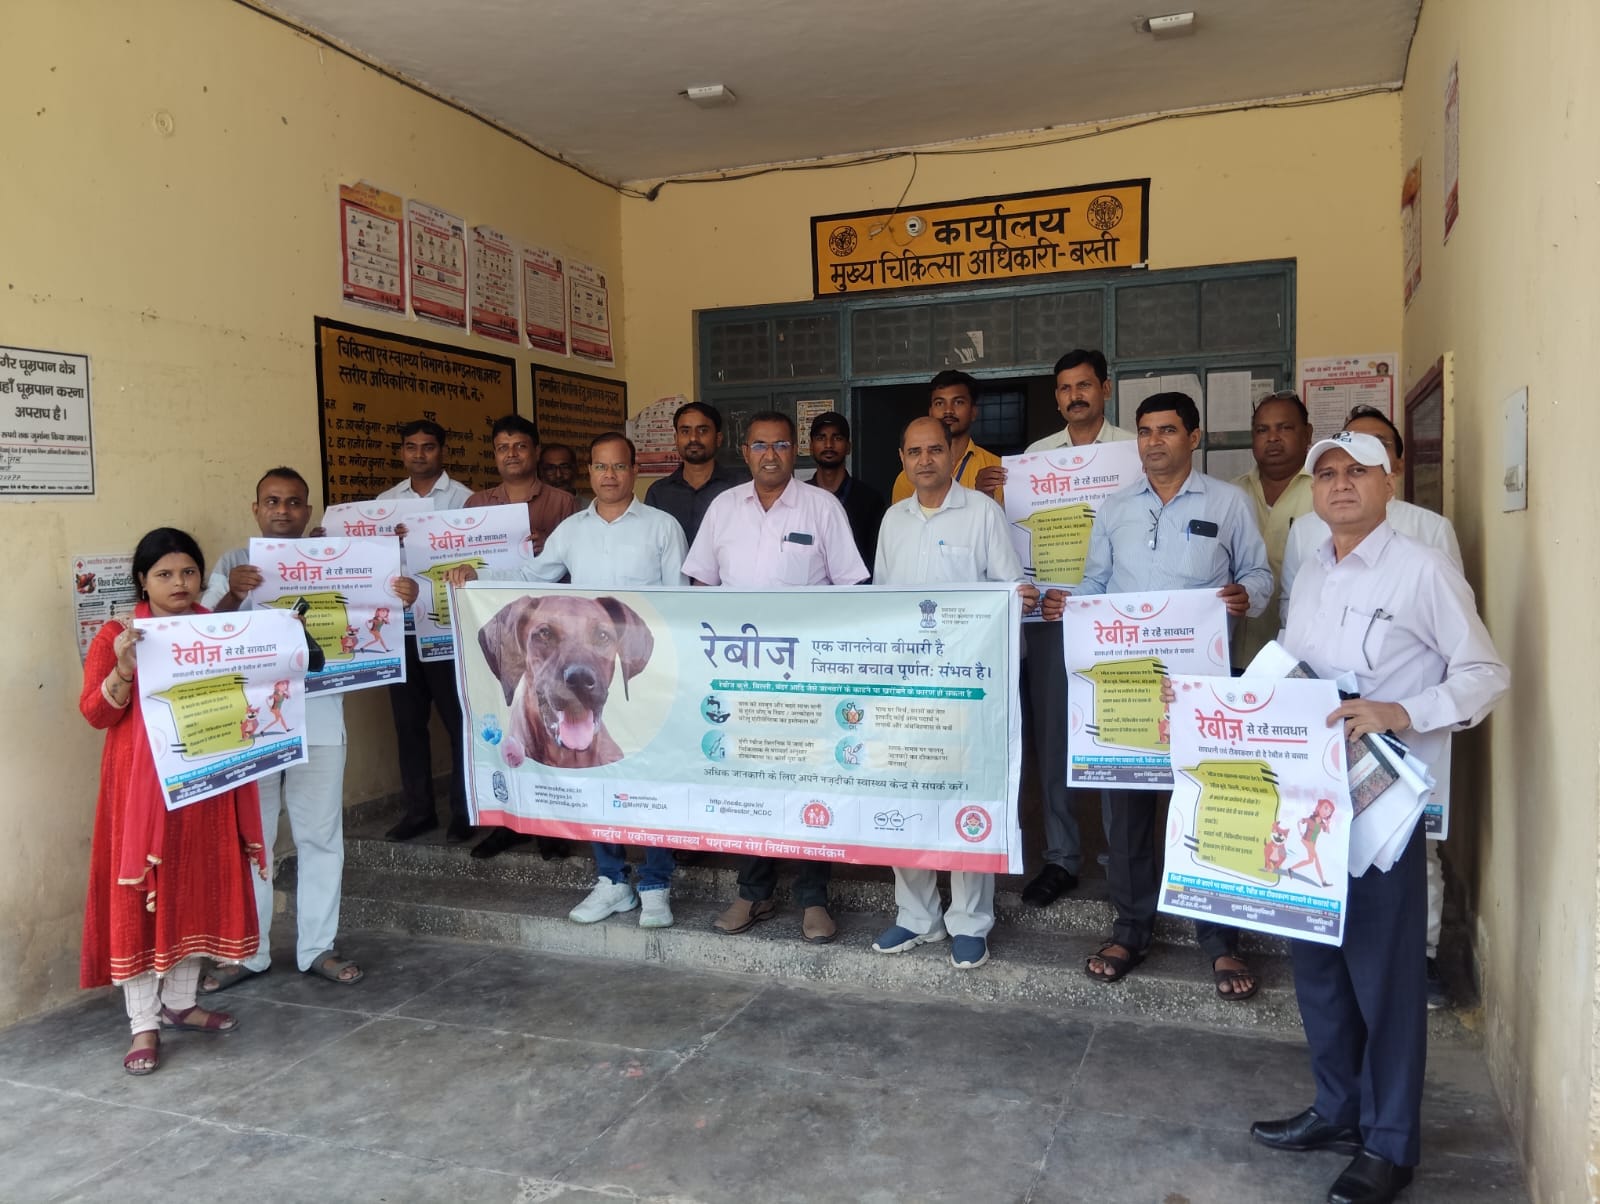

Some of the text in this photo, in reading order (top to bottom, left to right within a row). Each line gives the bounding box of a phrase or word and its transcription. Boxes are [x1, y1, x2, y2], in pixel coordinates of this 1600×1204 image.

[932, 203, 1071, 246] कार्यालय
[829, 261, 878, 291] मुख्य
[879, 249, 965, 284] चिकित्सा
[336, 336, 375, 362] चिकित्सा
[389, 350, 419, 369] स्वास्थ्य
[19, 359, 56, 376] धूम्रपान
[59, 360, 76, 375] क्षेत्र
[339, 363, 368, 384] स्तरीय
[369, 368, 417, 392] अधिकारियों
[418, 378, 429, 395] का
[430, 380, 446, 395] नाम
[17, 383, 54, 400] धूम्रपान
[56, 386, 85, 398] करना
[15, 404, 67, 421] अपराध है।
[352, 401, 437, 423] नाम पद
[1030, 472, 1071, 497] रेबीज़
[1073, 475, 1080, 485] से
[1093, 474, 1119, 484] सावधान
[428, 530, 466, 551] रेबीज़
[278, 561, 323, 584] रेबीज़
[326, 566, 333, 575] से
[346, 567, 373, 575] सावधान
[1093, 619, 1140, 647] रेबीज़
[1142, 627, 1149, 637] से
[1163, 627, 1195, 636] सावधान
[172, 641, 223, 667] रेबीज़
[225, 646, 233, 656] से
[246, 643, 277, 654] सावधान
[700, 622, 800, 680] रेबीज़
[811, 638, 945, 656] एक जानलेवा बीमारी है
[811, 658, 855, 674] जिसका
[858, 663, 893, 675] बचाव
[938, 661, 972, 678] संभव
[1195, 708, 1244, 746] रेबीज़
[1246, 722, 1255, 735] से
[1270, 725, 1307, 736] सावधान
[703, 767, 730, 777] अधिक
[732, 769, 765, 780] जानकारी
[767, 770, 777, 780] के
[779, 770, 797, 784] लिए
[798, 773, 818, 783] अपने
[855, 778, 887, 787] स्वास्थ्य
[909, 779, 918, 789] से
[744, 838, 763, 851] रोग
[764, 840, 801, 854] नियंत्रण
[803, 845, 846, 858] कार्यक्रम
